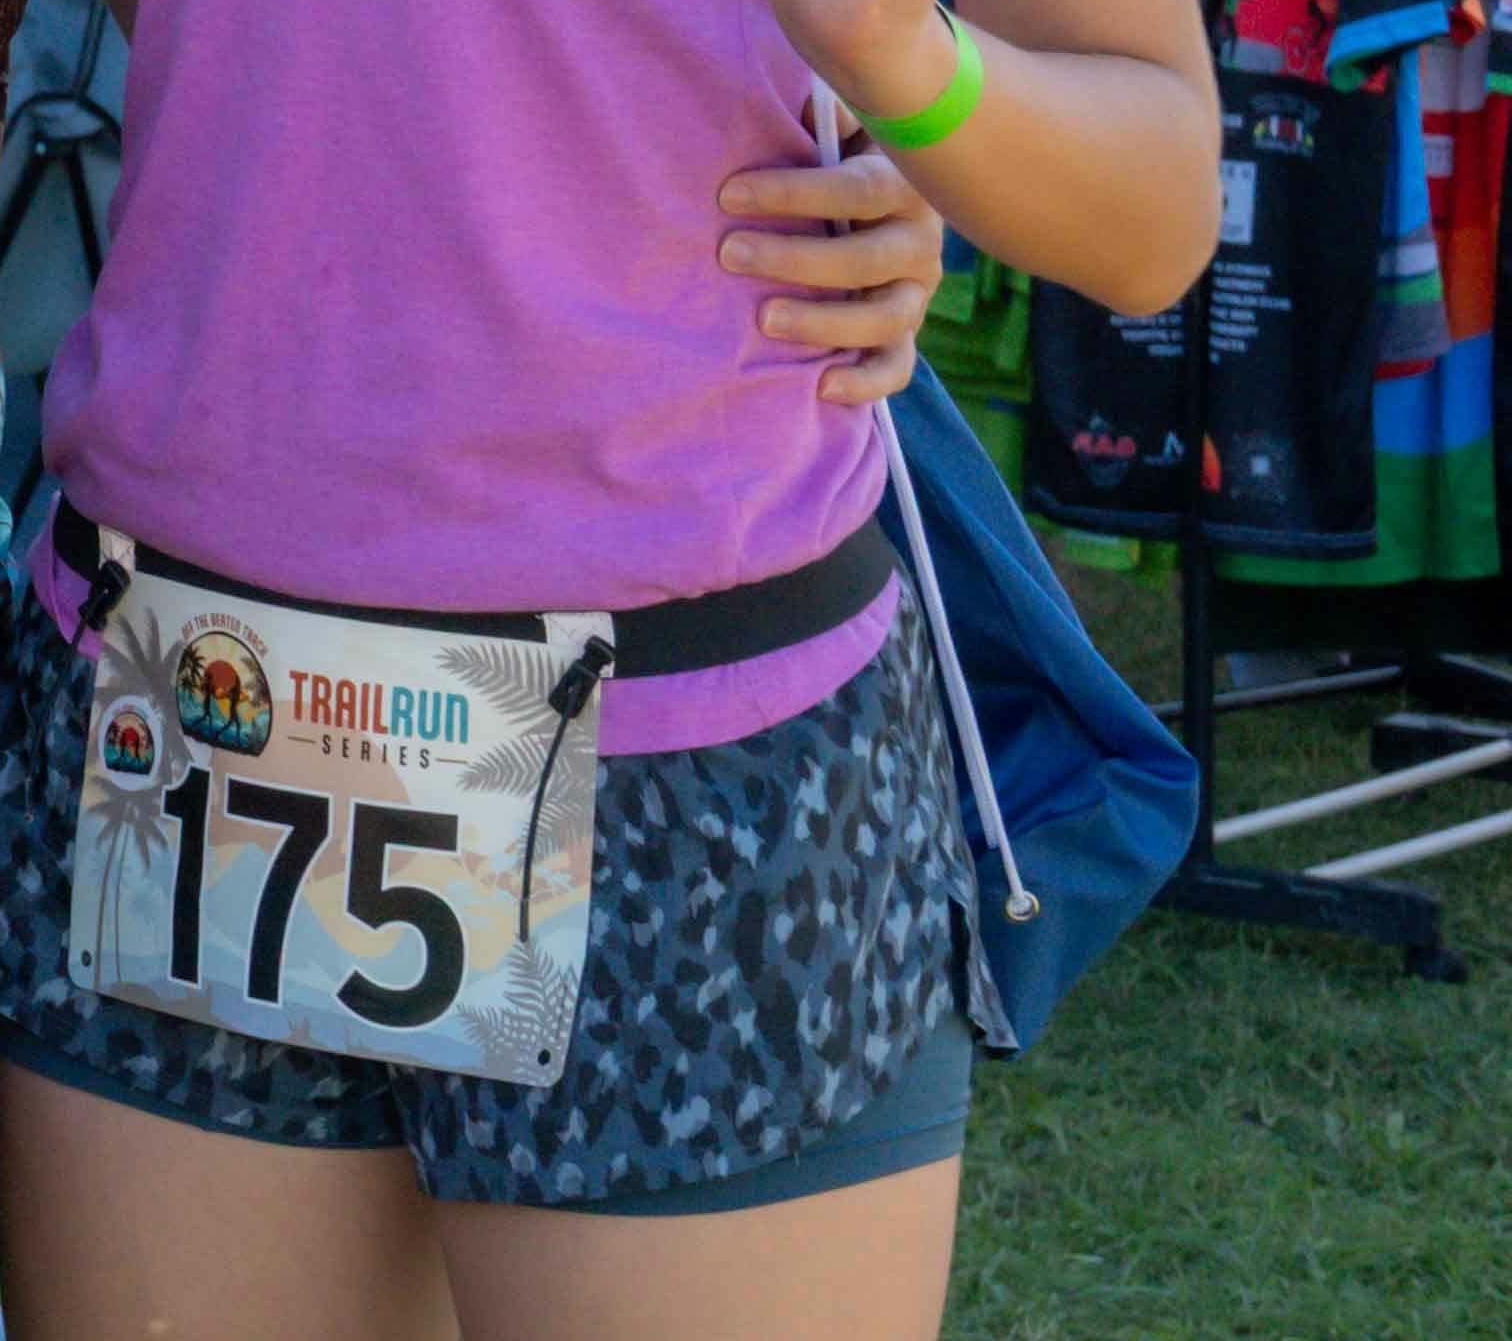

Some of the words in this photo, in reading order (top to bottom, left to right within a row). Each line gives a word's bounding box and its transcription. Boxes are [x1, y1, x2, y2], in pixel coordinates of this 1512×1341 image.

[288, 668, 470, 746] TRAILRUN
[320, 734, 431, 771] SERIES
[163, 764, 466, 1030] 175
